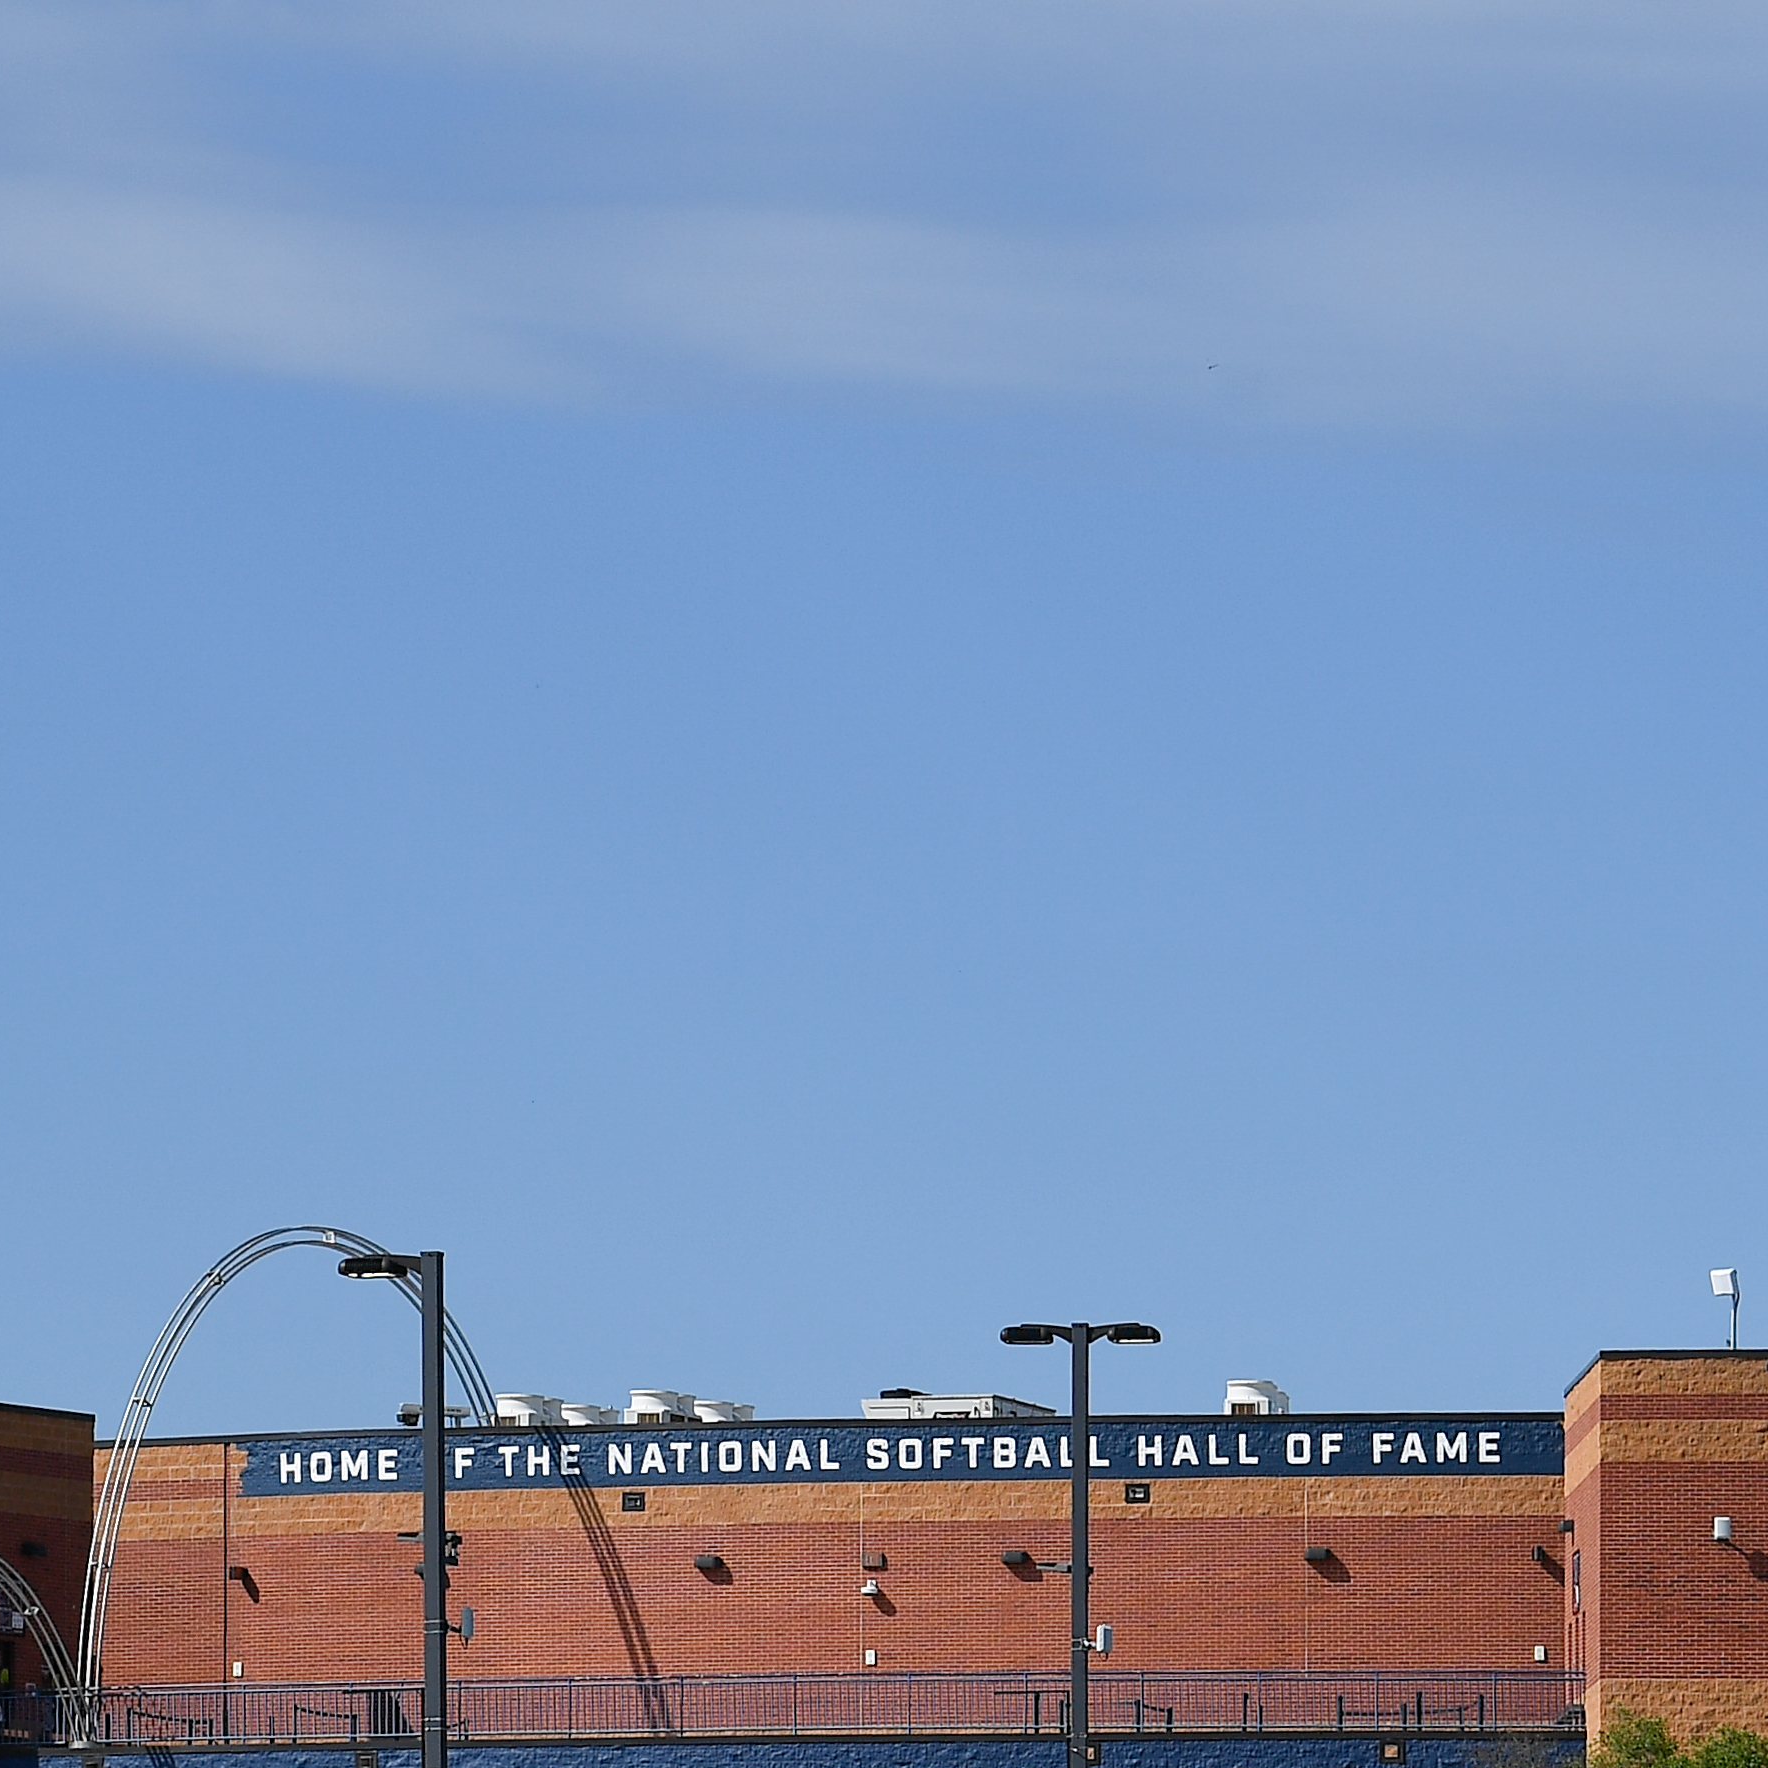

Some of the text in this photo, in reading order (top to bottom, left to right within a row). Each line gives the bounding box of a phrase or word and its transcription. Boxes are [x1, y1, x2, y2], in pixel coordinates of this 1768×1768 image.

[278, 1446, 399, 1484] HOME
[497, 1441, 582, 1478] THE
[606, 1436, 842, 1475] NATIONAL
[864, 1433, 1110, 1471] SOFTBALL
[1136, 1431, 1260, 1467] HALL
[1284, 1430, 1344, 1466] OF
[1371, 1429, 1502, 1465] FAME
